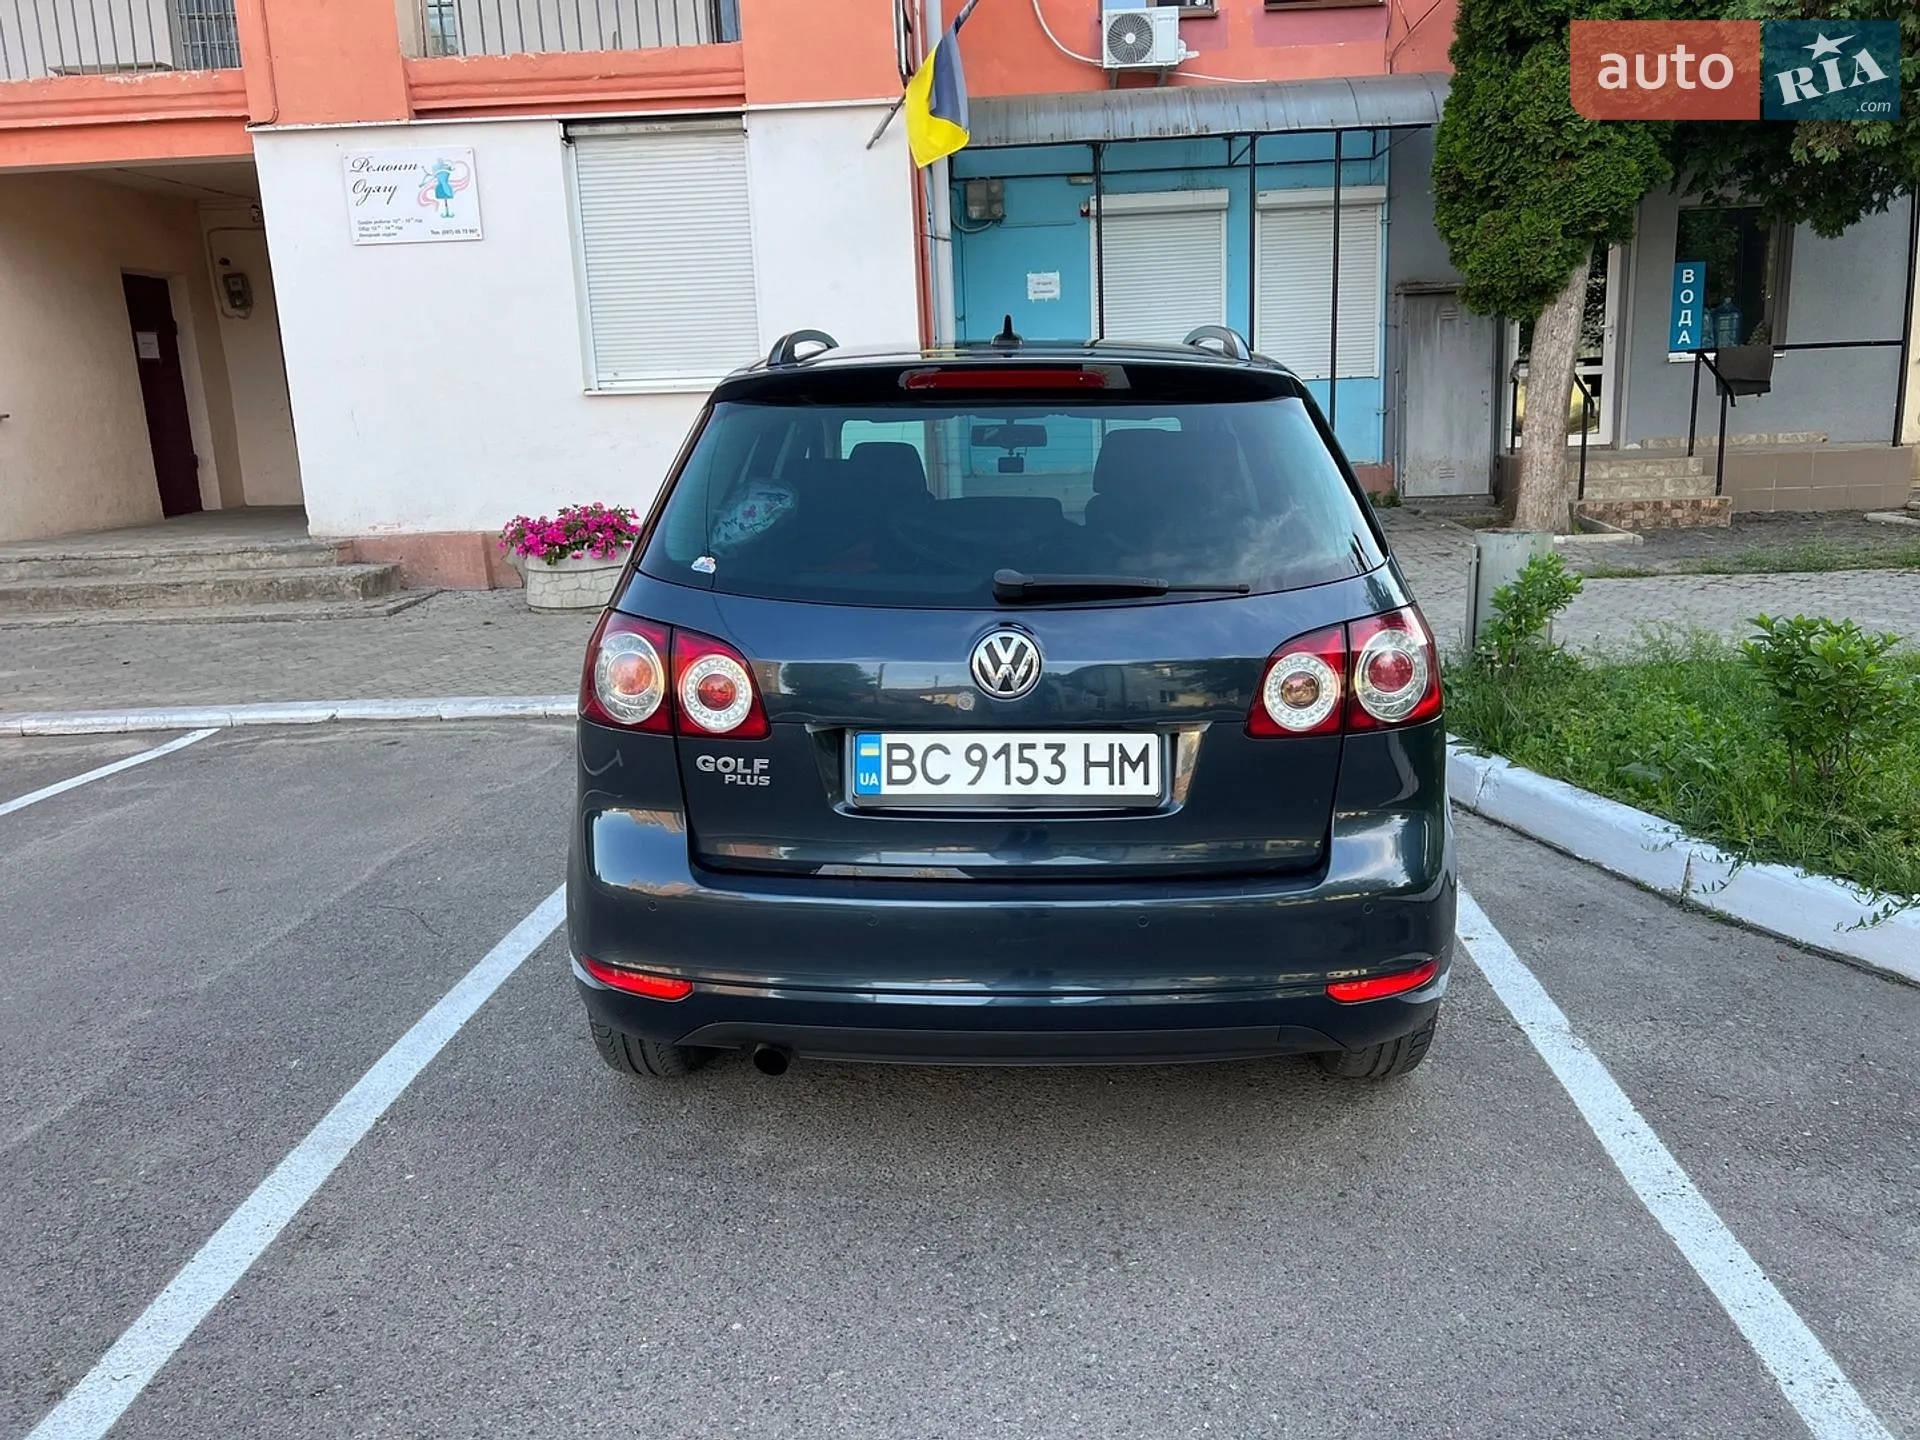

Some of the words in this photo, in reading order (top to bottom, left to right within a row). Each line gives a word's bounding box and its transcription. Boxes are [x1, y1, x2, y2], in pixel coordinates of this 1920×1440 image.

[349, 155, 418, 173] Ремонт
[351, 178, 399, 206] Одягу
[1677, 269, 1695, 345] ВОДА
[696, 754, 770, 774] GOLF
[886, 742, 951, 786] BC
[964, 742, 1067, 786] 9153
[1083, 742, 1150, 786] HM
[724, 774, 771, 786] PLUS
[859, 773, 879, 786] UA
